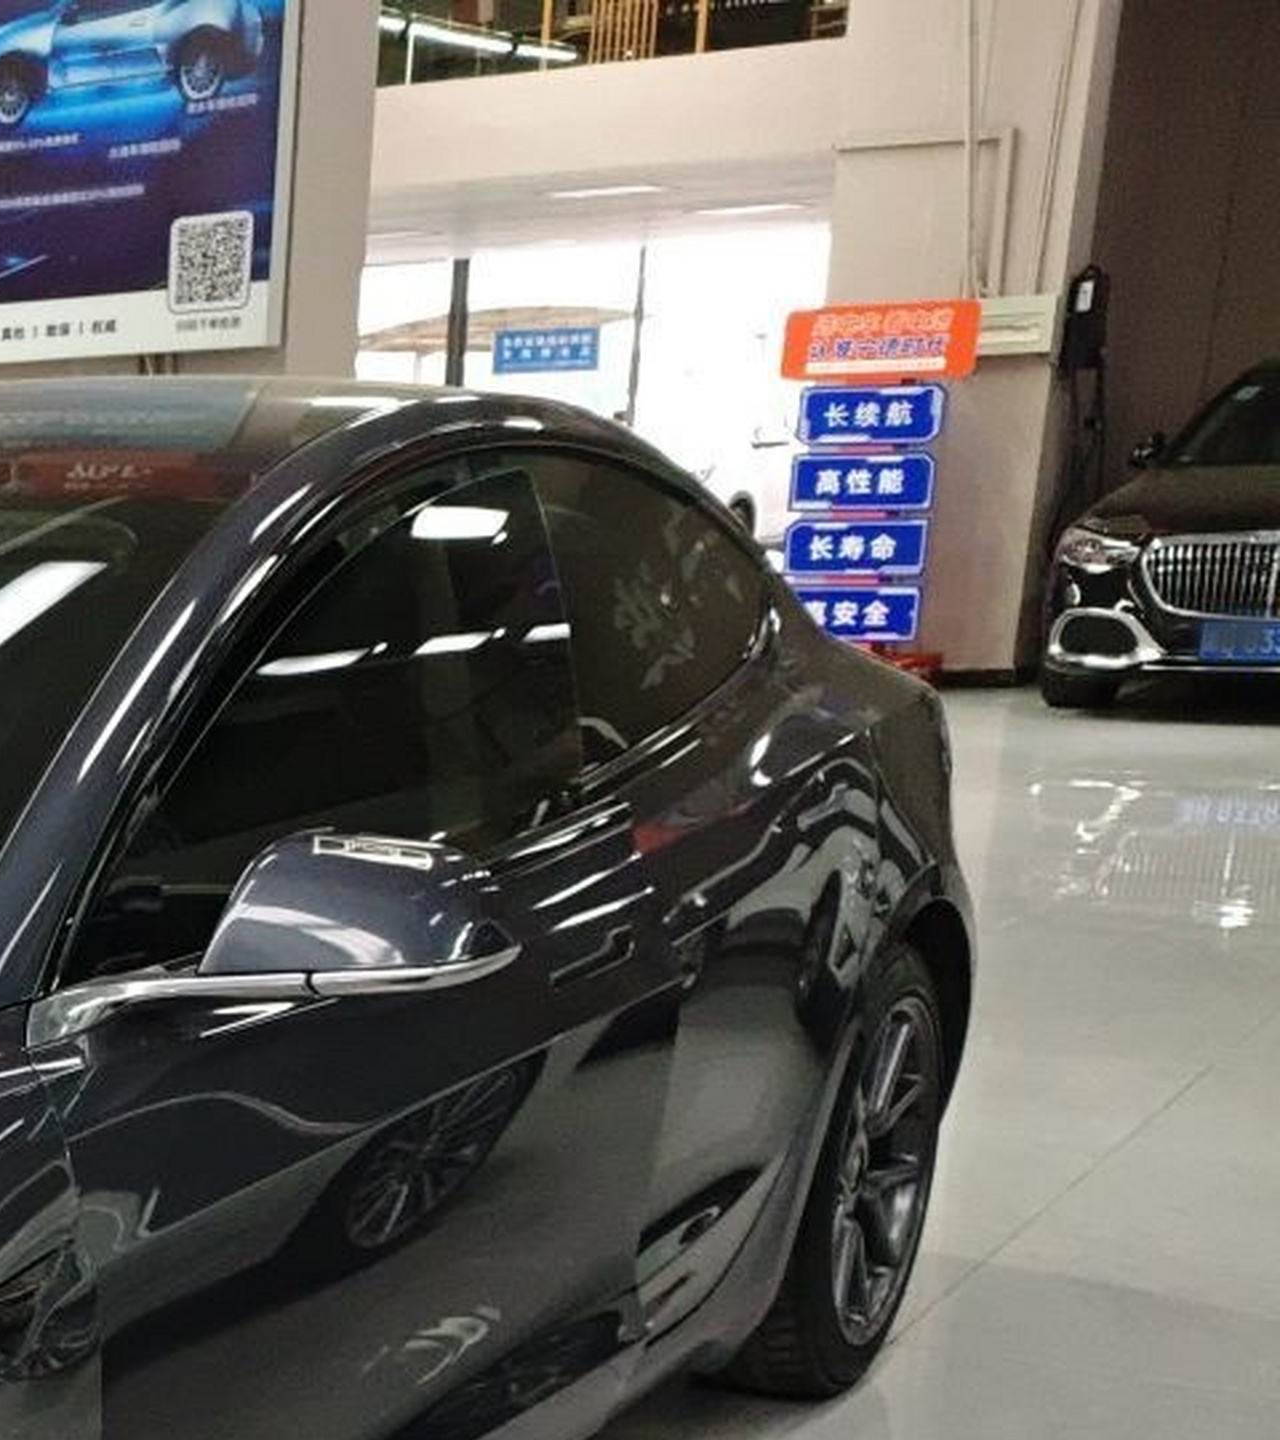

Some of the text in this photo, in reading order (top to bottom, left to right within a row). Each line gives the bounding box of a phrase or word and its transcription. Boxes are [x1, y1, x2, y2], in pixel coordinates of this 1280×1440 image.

[824, 401, 914, 428] 长续航
[815, 468, 906, 495] 高性能
[809, 534, 897, 560] 长寿命
